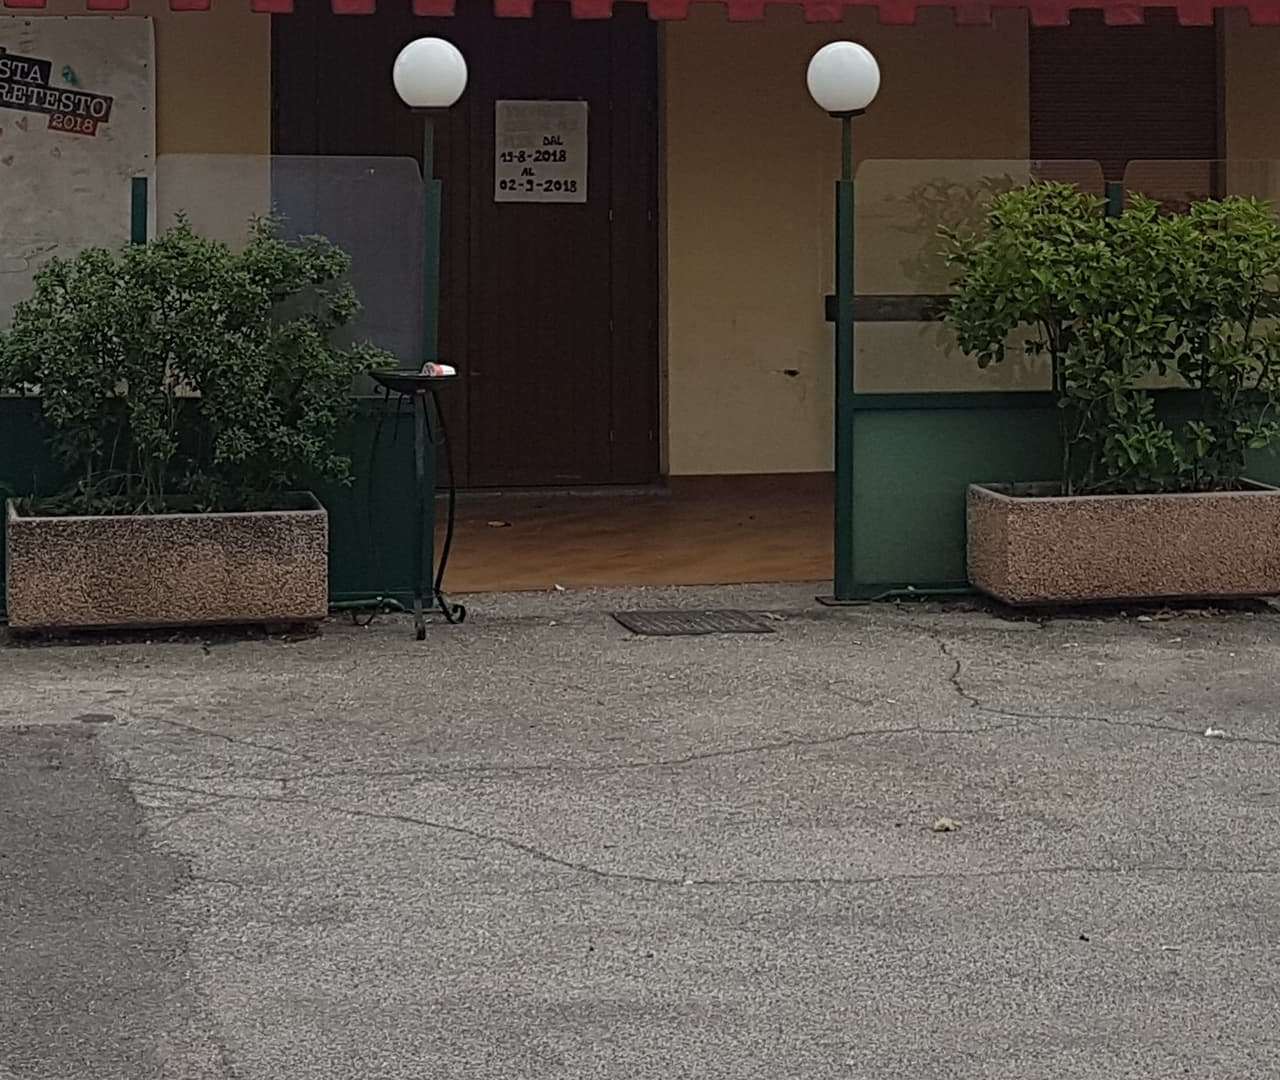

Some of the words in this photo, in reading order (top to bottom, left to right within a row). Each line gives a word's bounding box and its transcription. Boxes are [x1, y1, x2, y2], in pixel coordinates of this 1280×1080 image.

[51, 113, 94, 133] 2018
[542, 136, 563, 146] DAL
[521, 167, 535, 176] AL
